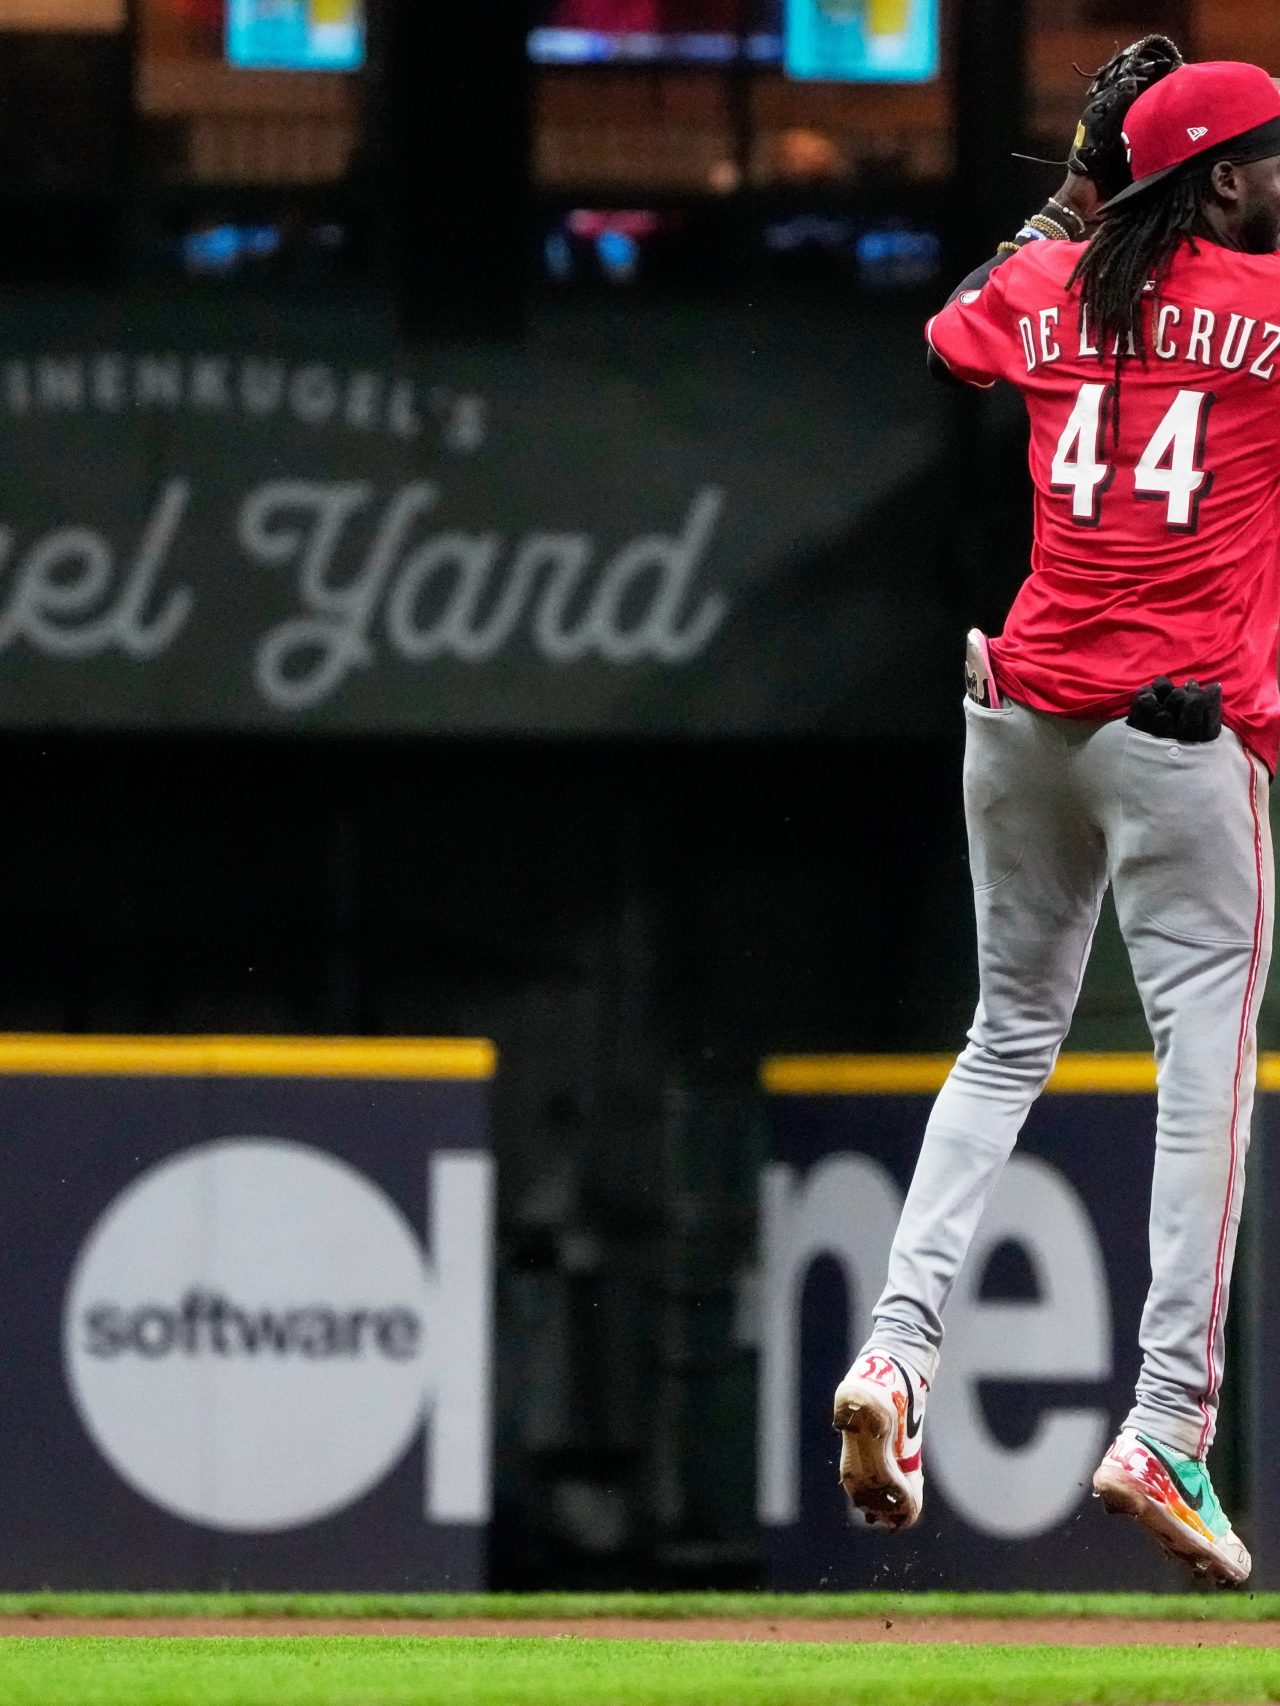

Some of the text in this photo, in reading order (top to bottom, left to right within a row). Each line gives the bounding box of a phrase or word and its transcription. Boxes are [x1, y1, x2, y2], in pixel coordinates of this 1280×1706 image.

[1018, 306, 1062, 372] DE
[1050, 383, 1213, 533] 44
[0, 476, 727, 711] el Yard
[83, 1284, 424, 1363] software
